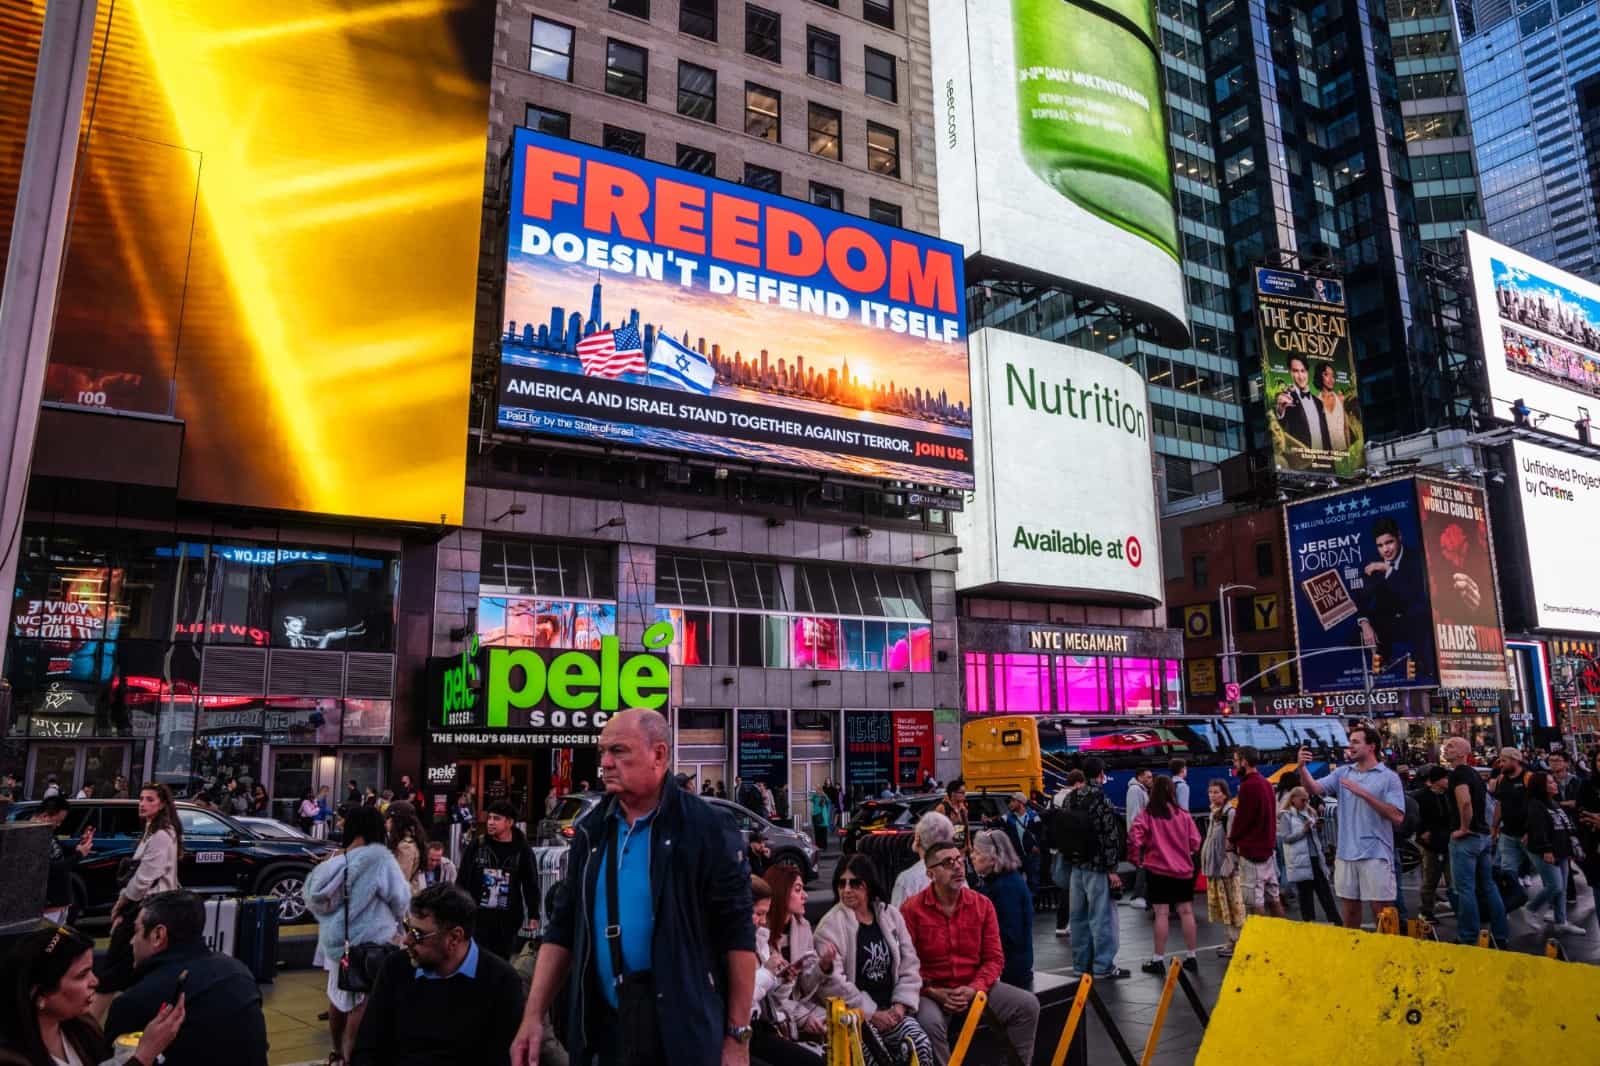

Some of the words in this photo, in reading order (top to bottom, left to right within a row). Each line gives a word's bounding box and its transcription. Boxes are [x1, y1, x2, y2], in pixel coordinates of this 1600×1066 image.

[522, 145, 957, 313] FREEDOM
[521, 224, 698, 287] DOESN'T
[709, 265, 849, 320] DEFEND
[860, 299, 959, 343] ITSELF
[1261, 306, 1291, 329] THE
[1294, 312, 1346, 337] GREAT
[1274, 330, 1339, 356] GATSBY
[1006, 363, 1147, 441] Nutrition
[506, 379, 583, 403] AMERICA
[586, 392, 623, 408] AND
[625, 397, 676, 417] ISRAEL
[679, 405, 727, 425] STAND
[730, 412, 803, 435] TOGETHER
[804, 426, 862, 445] AGAINST
[862, 434, 913, 453] TERROR.
[915, 441, 945, 457] JOIN
[947, 445, 969, 461] US.
[506, 411, 527, 421] Paid
[528, 413, 541, 425] for
[543, 415, 556, 428] by
[557, 417, 572, 428] the
[575, 420, 598, 432] State
[600, 424, 609, 433] of
[609, 425, 634, 437] Israel
[1522, 456, 1571, 482] Unfinished
[1525, 476, 1537, 498] by
[1539, 480, 1574, 501] Chrome
[1423, 496, 1449, 514] WORLD
[1450, 502, 1474, 520] COULD
[1013, 526, 1103, 557] Available
[1107, 539, 1123, 560] at
[1298, 533, 1360, 554] JEREMY
[1299, 545, 1362, 572] JORDAN
[1188, 611, 1209, 635] O
[1256, 601, 1275, 628] Y
[1031, 631, 1061, 649] NYC
[1065, 634, 1129, 652] MEGAMART
[487, 621, 675, 727] pelé
[1273, 697, 1314, 710] GIFTS
[1326, 692, 1399, 707] LUGGAGE
[530, 710, 608, 728] SOCC
[432, 733, 451, 743] THE
[454, 733, 498, 743] WORLD'S
[500, 734, 550, 744] GREATEST
[552, 734, 590, 744] SOCCER
[428, 762, 457, 780] pelé
[197, 853, 223, 861] UBER
